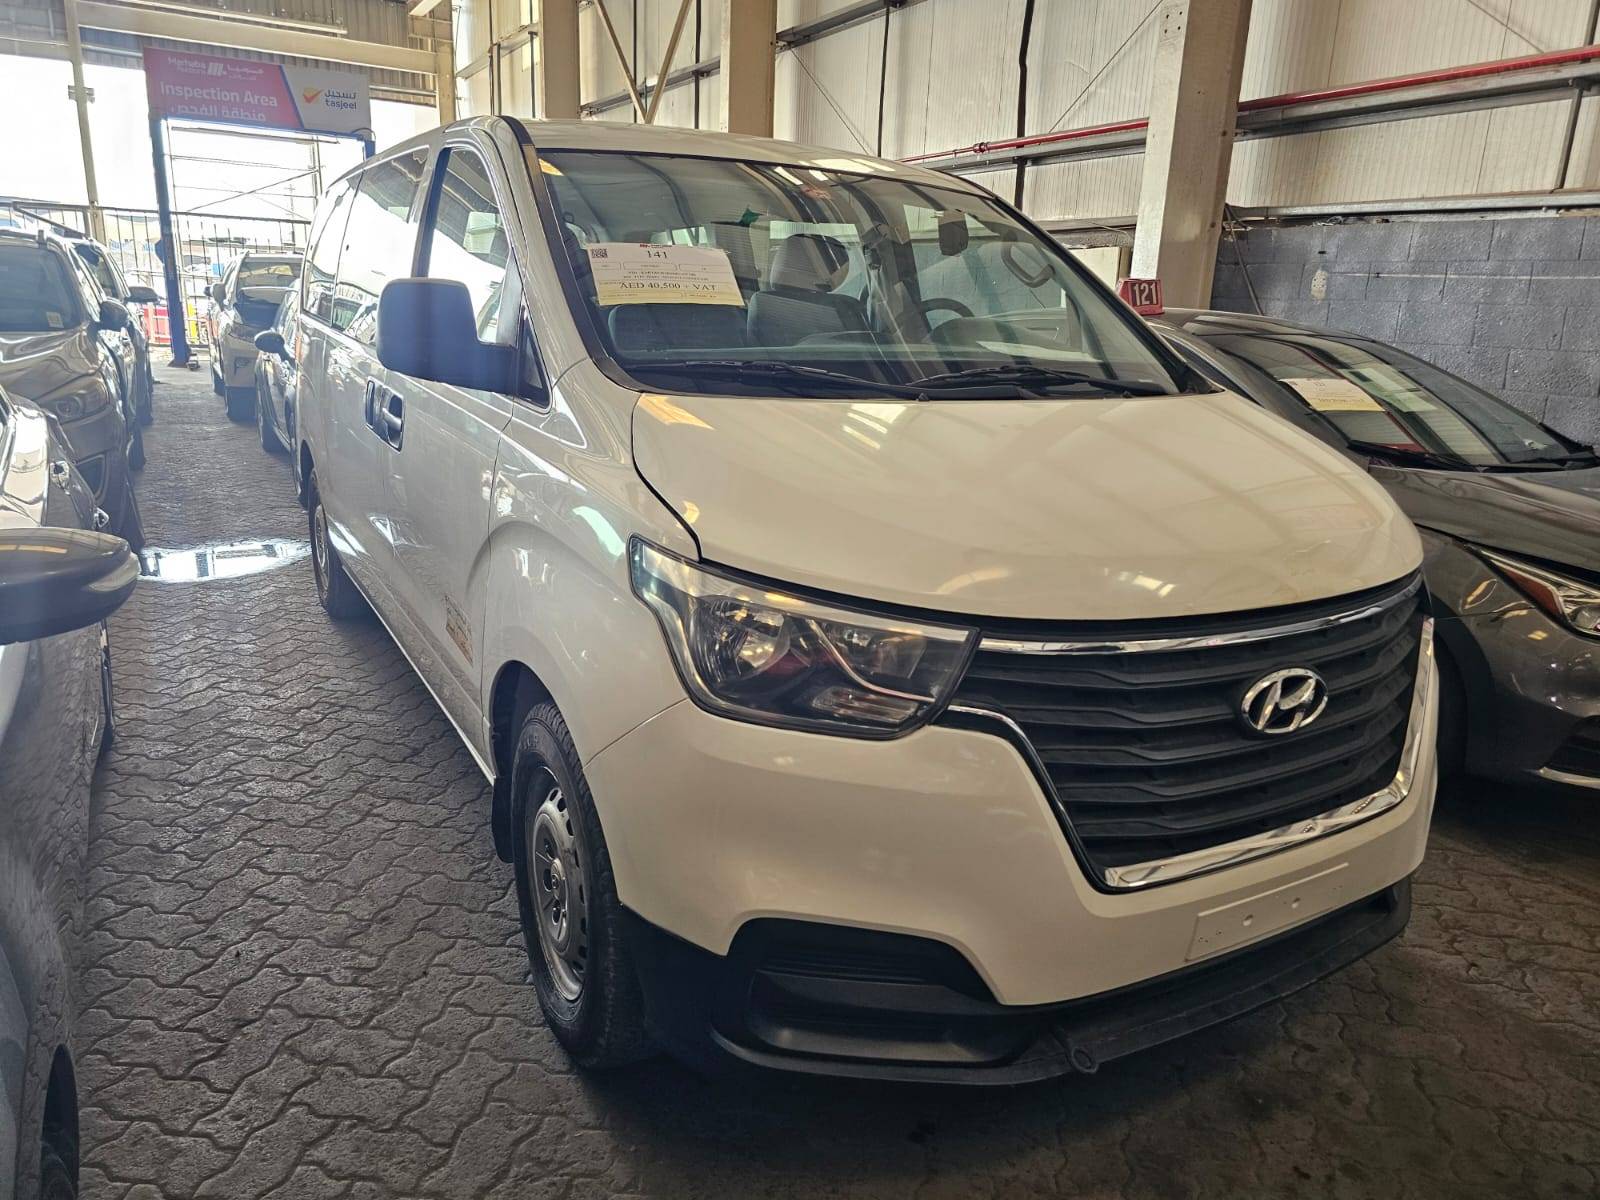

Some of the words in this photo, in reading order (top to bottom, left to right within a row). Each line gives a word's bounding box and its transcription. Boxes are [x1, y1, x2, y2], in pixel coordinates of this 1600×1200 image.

[160, 81, 240, 103] Inspection
[243, 90, 278, 107] Area
[325, 98, 357, 111] tasjeel
[647, 250, 668, 259] 141
[692, 283, 716, 291] VAT
[1133, 281, 1158, 306] 121
